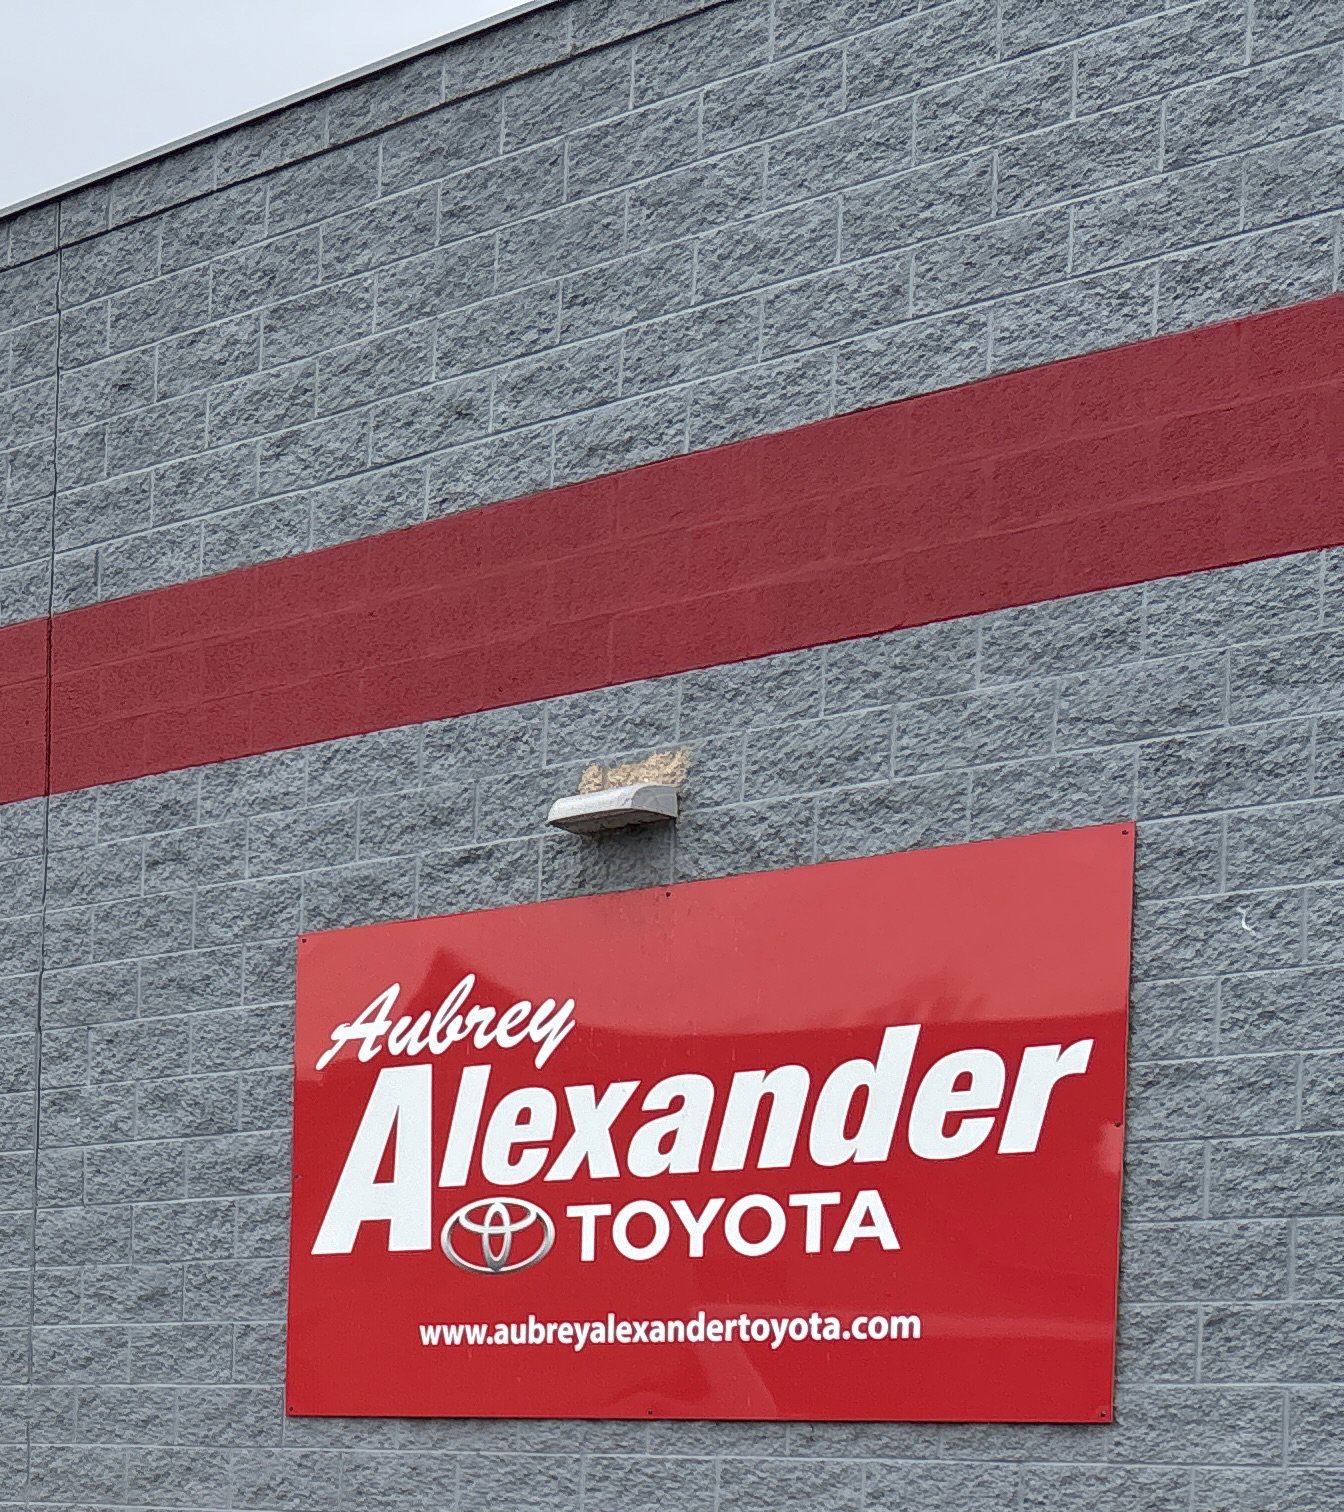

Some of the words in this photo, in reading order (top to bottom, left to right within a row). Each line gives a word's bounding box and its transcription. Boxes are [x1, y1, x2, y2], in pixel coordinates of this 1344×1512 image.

[315, 973, 576, 1071] Aubrey
[310, 1023, 1094, 1255] Alexander
[566, 1189, 902, 1262] TOYOTA
[419, 1310, 922, 1351] www.aubreyalexandertoyota.com
